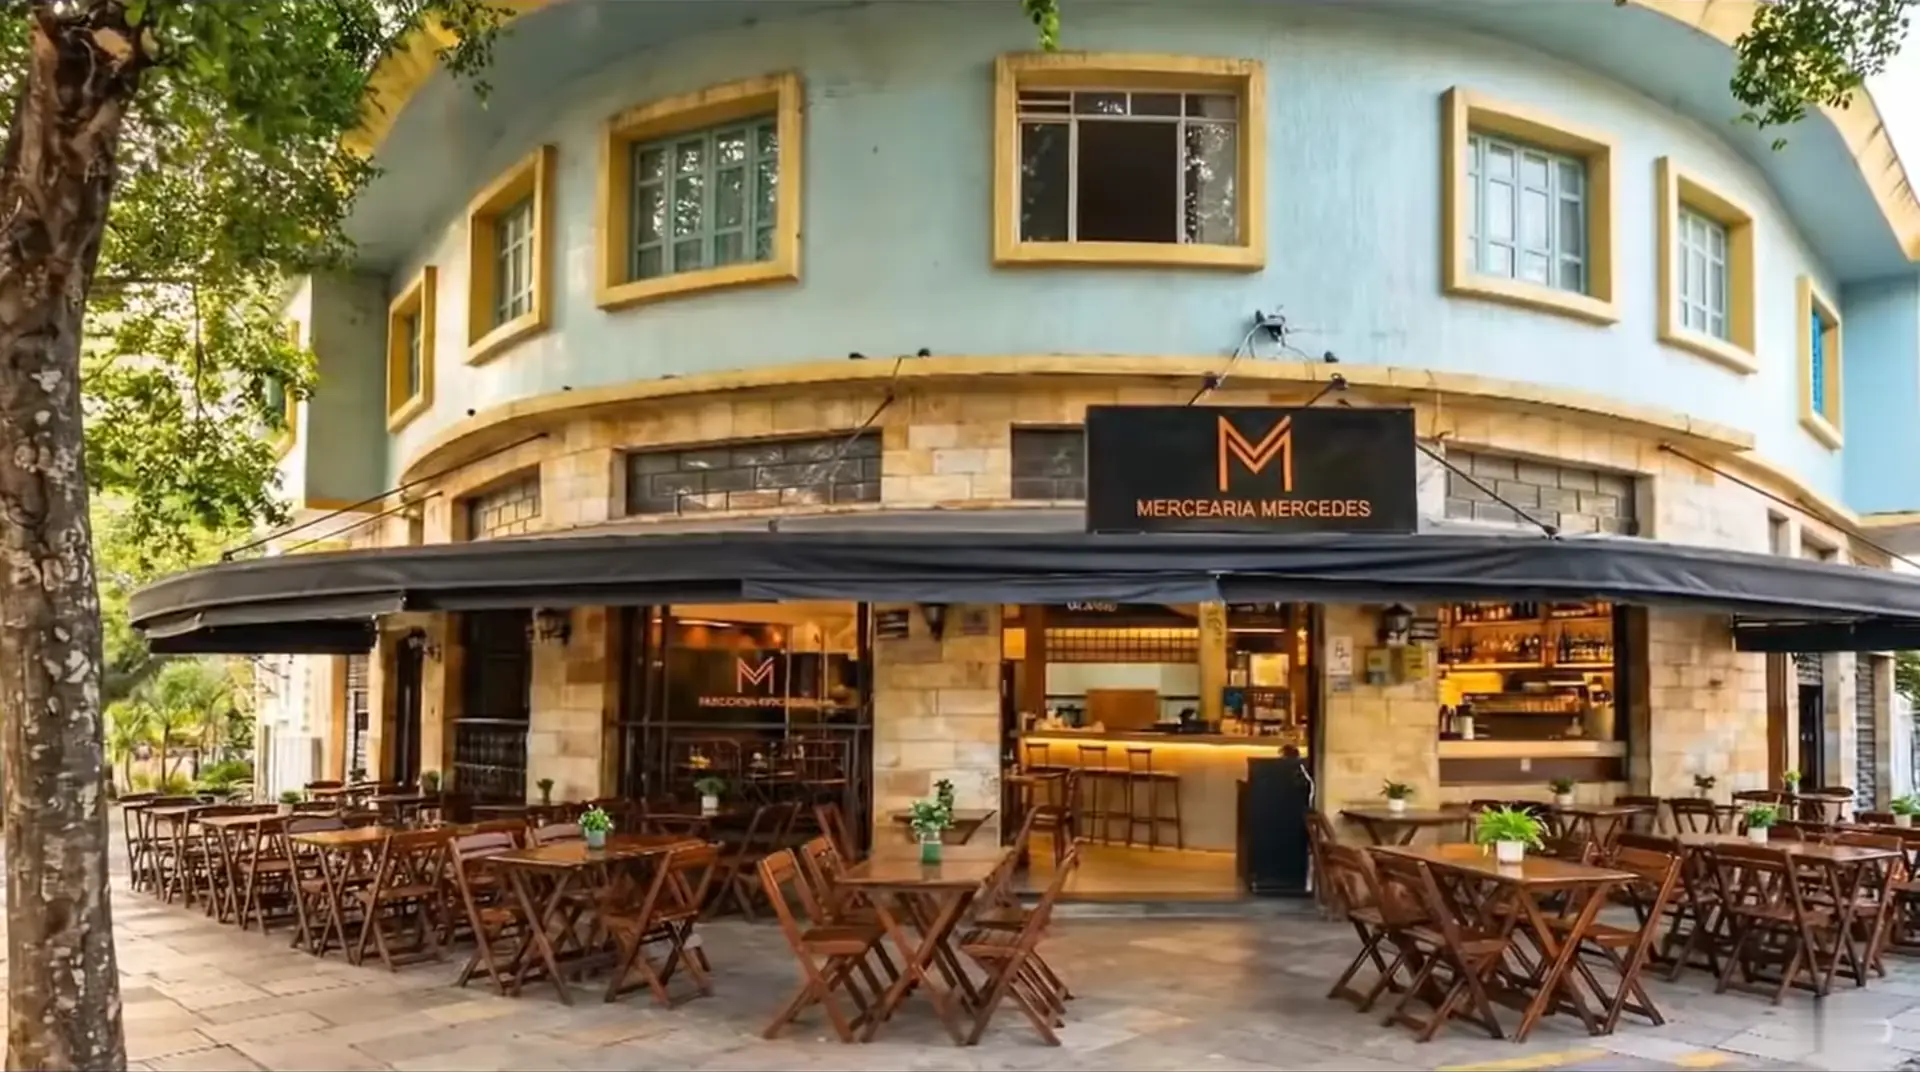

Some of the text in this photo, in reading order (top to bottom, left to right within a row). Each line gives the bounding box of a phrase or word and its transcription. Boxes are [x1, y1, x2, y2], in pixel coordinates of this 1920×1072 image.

[1218, 415, 1293, 492] M
[1137, 499, 1372, 517] MERCEARIA MERCEDES
[736, 656, 775, 694] M
